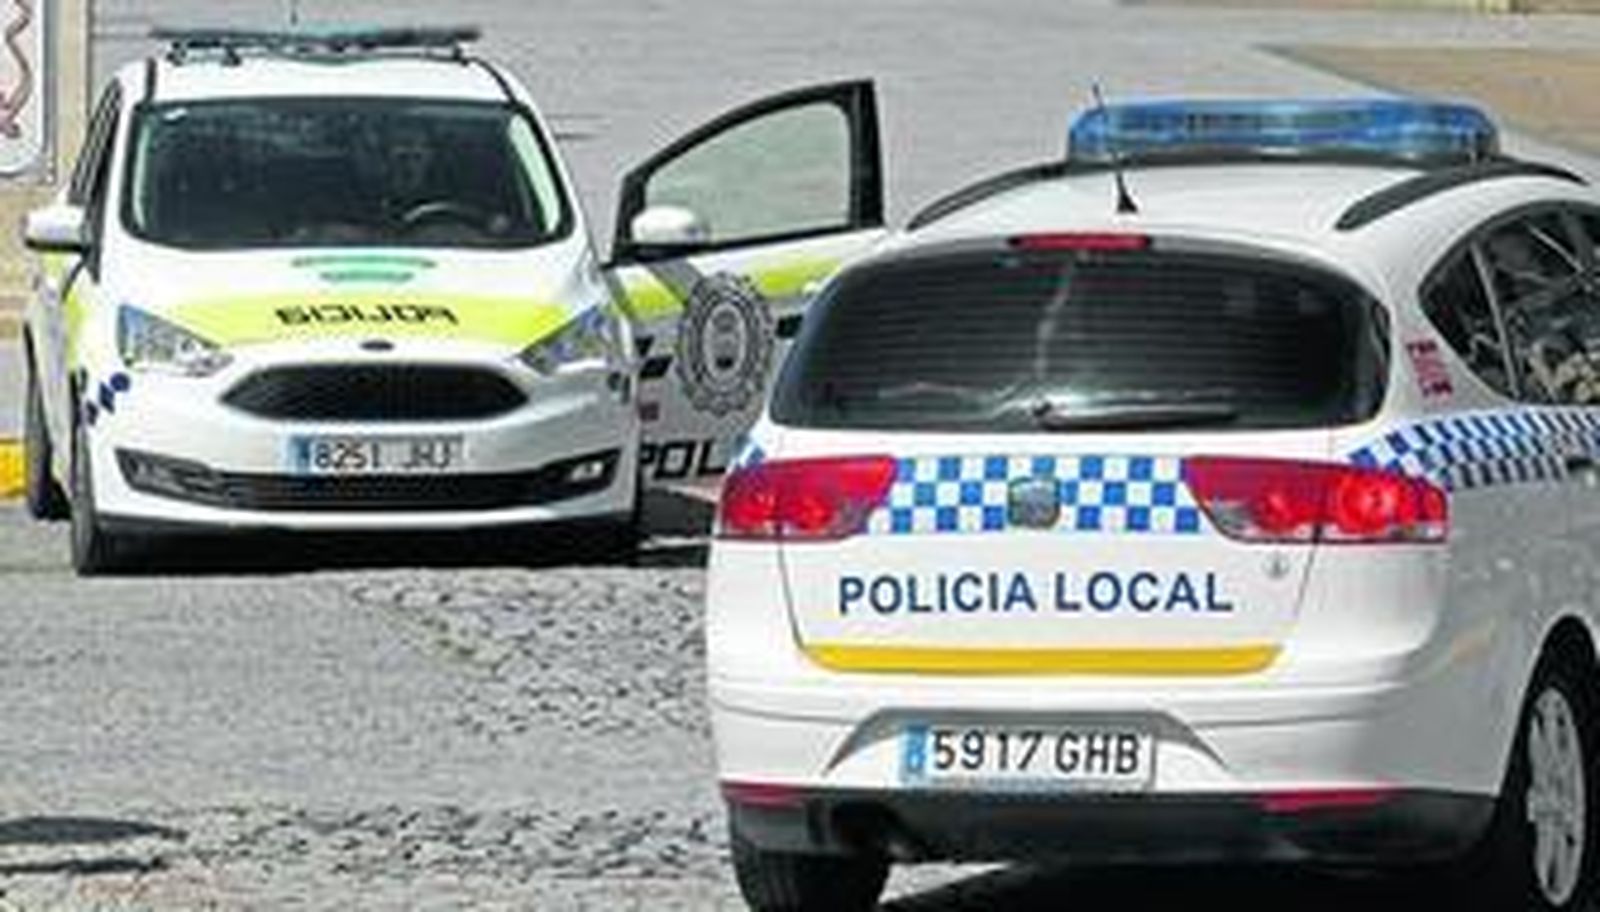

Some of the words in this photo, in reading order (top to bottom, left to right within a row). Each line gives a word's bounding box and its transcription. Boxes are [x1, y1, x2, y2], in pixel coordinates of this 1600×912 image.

[314, 441, 380, 468] 8251
[839, 573, 1037, 615] POLICIA
[1053, 571, 1233, 613] LOCAL
[933, 729, 1043, 770] 5917
[1055, 732, 1141, 774] GHB
